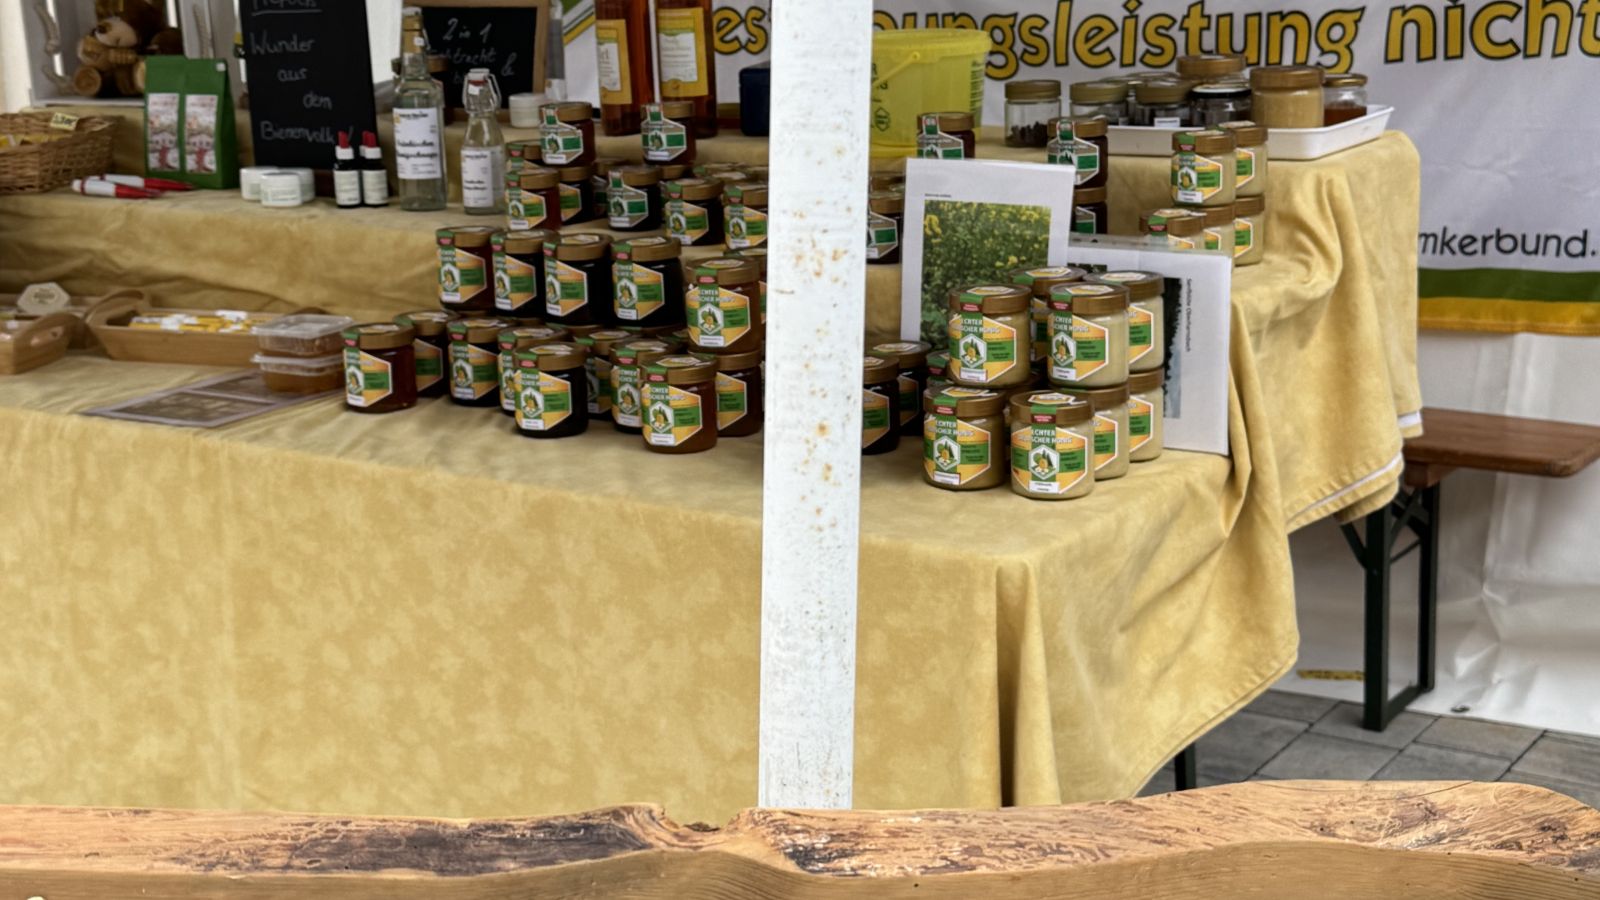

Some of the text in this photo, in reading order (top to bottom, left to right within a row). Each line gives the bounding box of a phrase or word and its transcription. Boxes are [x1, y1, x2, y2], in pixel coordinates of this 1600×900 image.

[250, 29, 315, 55] Wunder
[442, 17, 459, 41] 2
[479, 22, 492, 43] 1
[277, 68, 308, 82] aus
